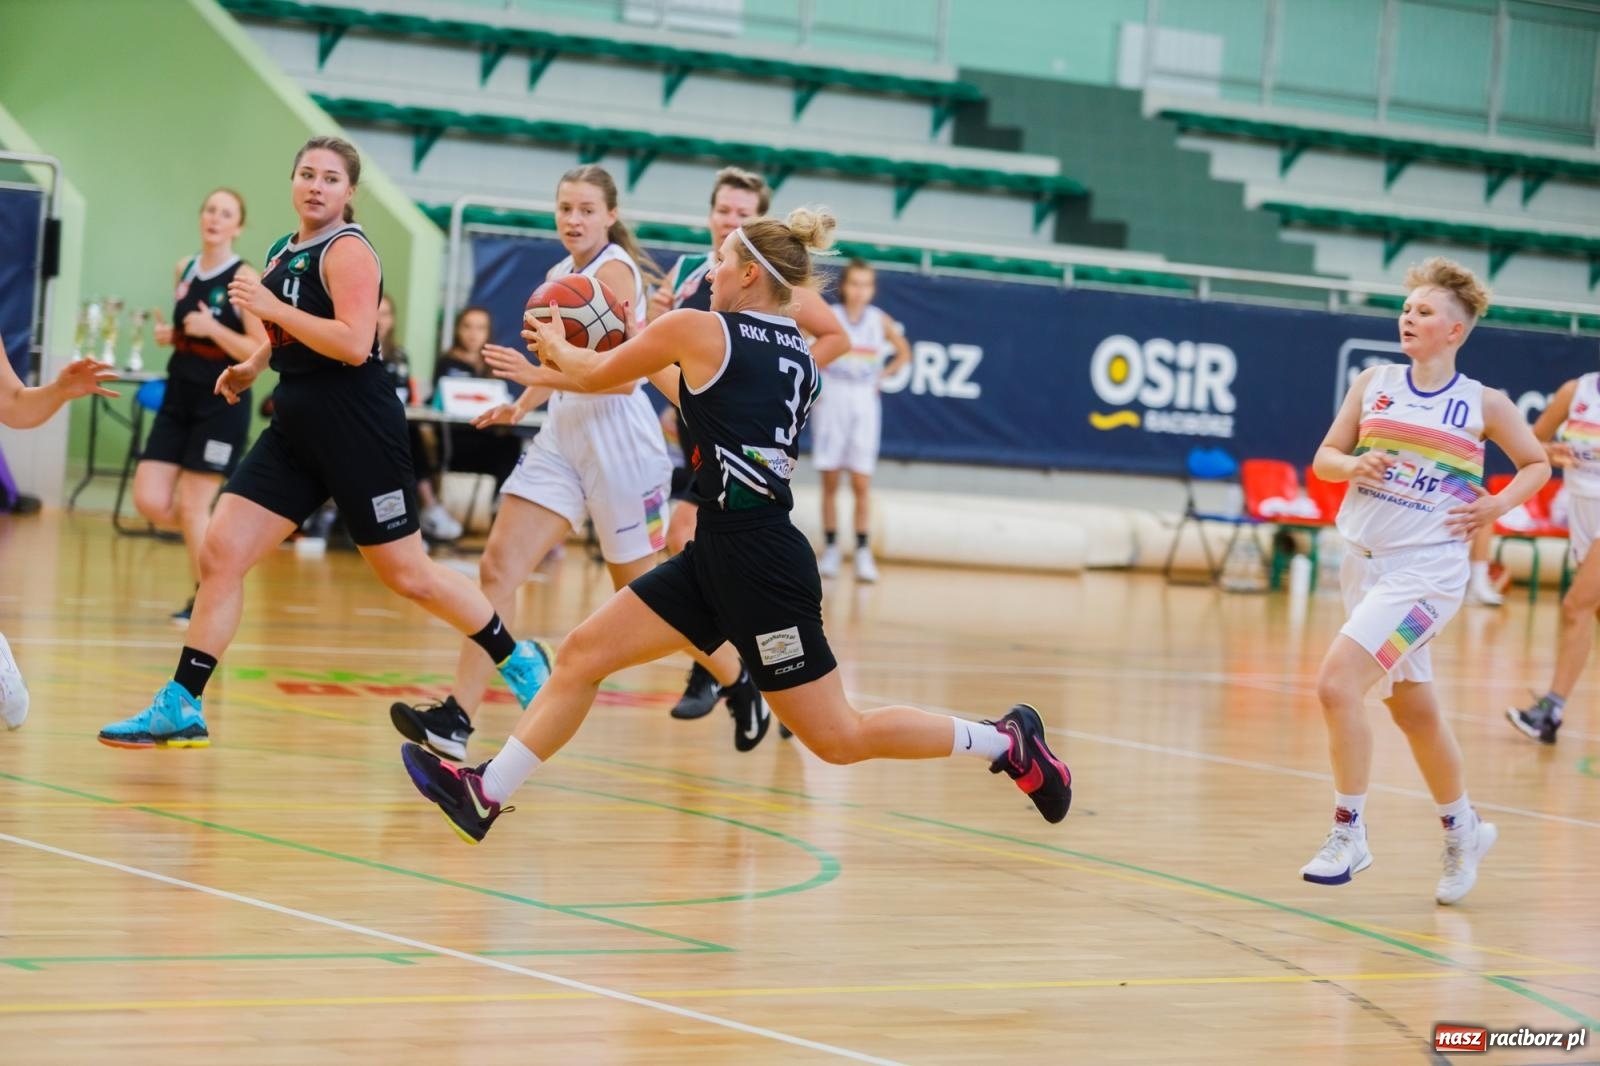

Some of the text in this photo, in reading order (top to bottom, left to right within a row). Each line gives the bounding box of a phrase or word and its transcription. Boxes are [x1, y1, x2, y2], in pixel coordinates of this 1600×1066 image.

[283, 276, 300, 307] 4
[739, 323, 770, 343] RKK
[775, 356, 805, 446] 3
[1442, 398, 1469, 428] 10
